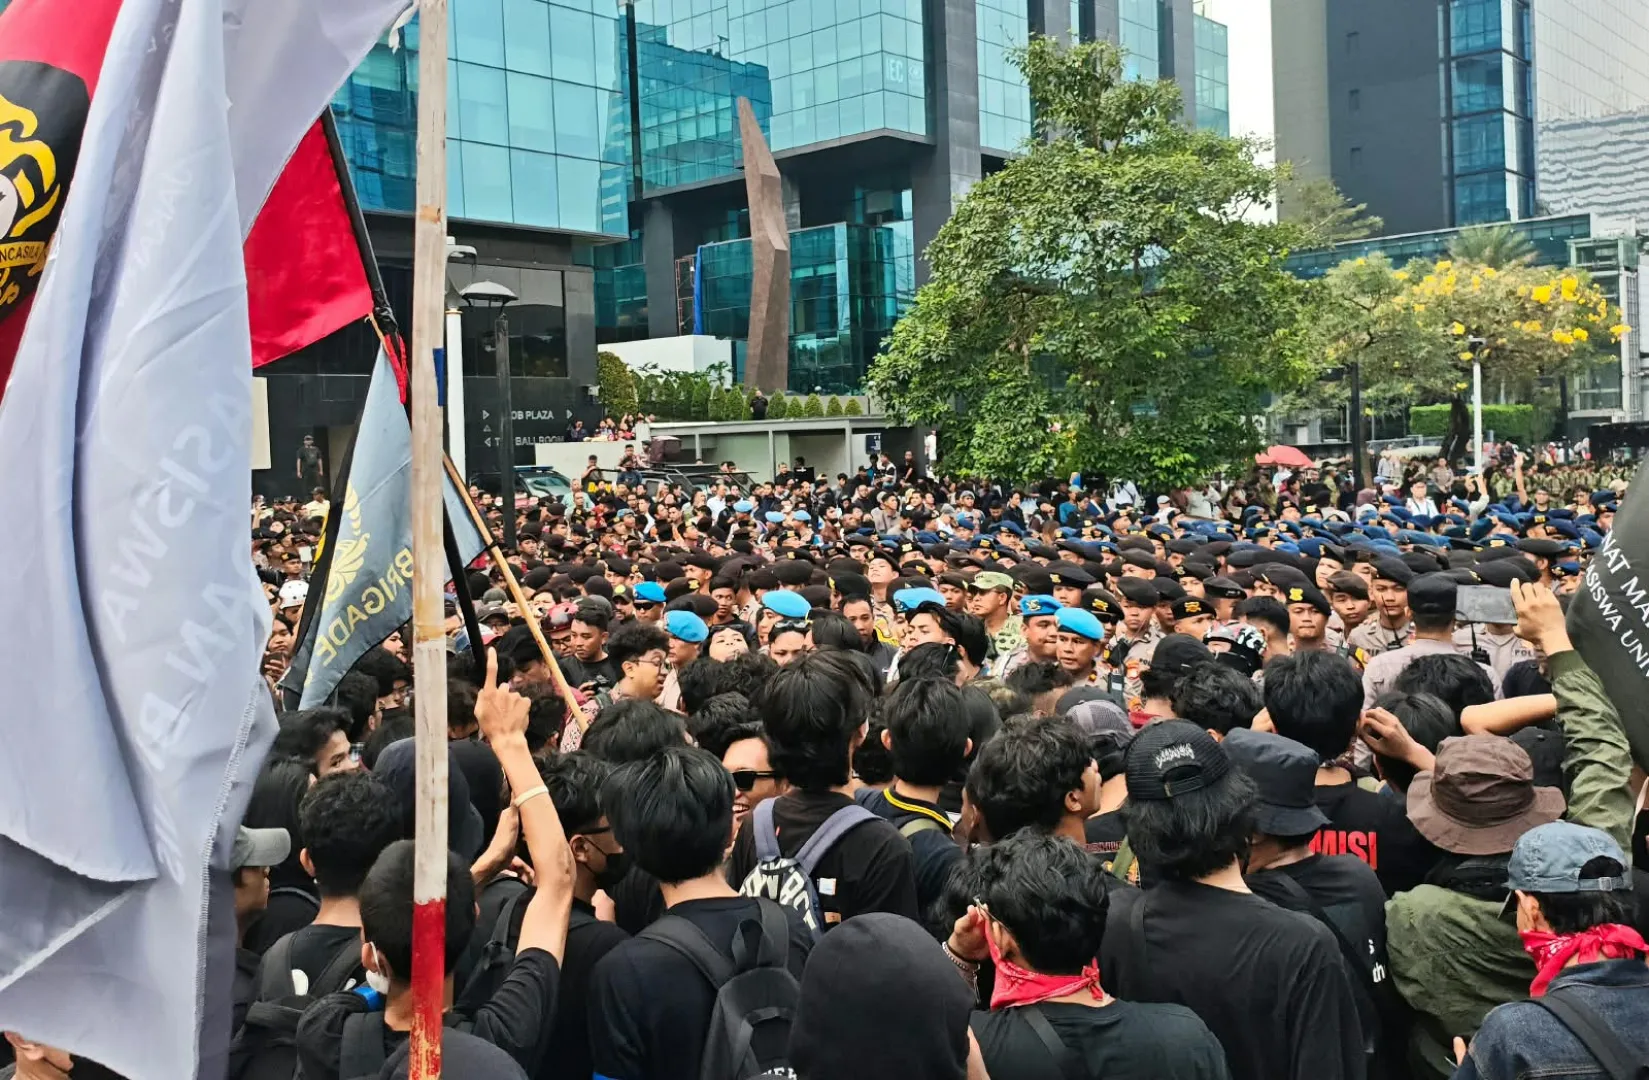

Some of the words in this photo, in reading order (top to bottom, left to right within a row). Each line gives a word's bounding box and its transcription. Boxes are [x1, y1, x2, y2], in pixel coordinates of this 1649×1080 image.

[525, 410, 554, 420] PLAZA
[1586, 558, 1623, 632] ASISWA
[1620, 576, 1649, 628] MA
